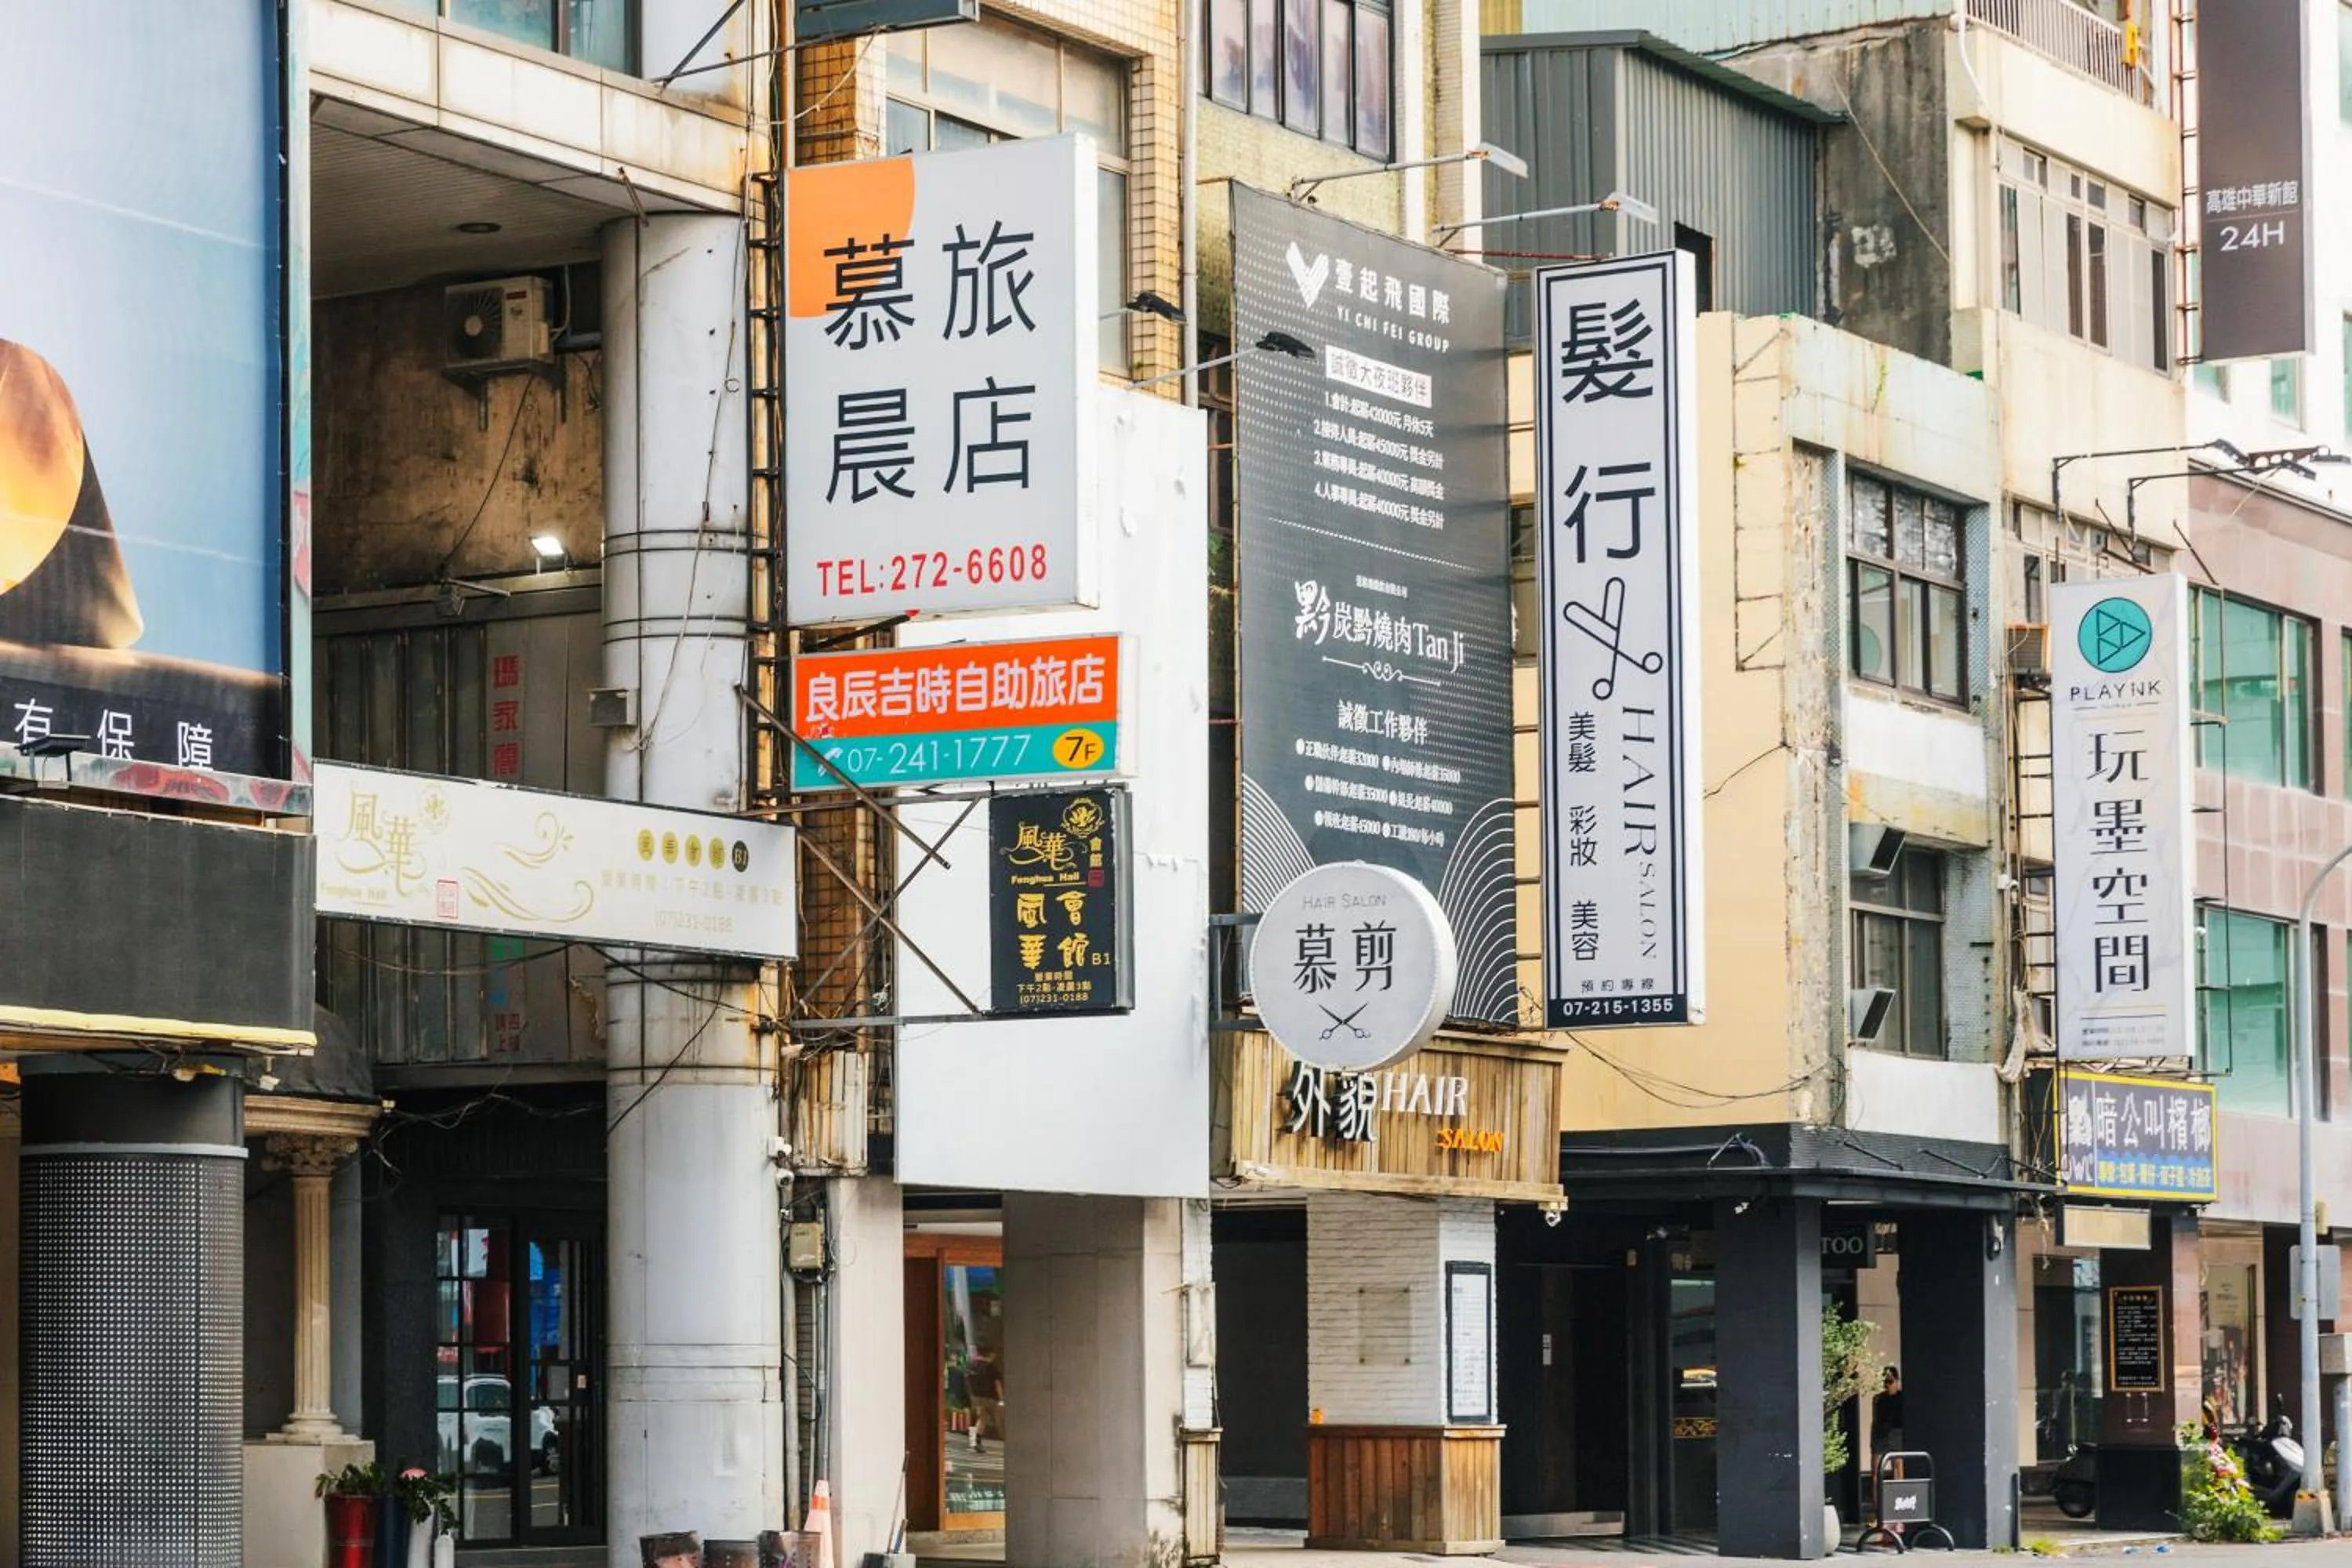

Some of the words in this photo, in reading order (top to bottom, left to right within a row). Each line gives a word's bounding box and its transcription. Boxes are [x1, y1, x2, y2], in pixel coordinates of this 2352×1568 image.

[2205, 180, 2299, 213] 高雄中華新館
[2220, 220, 2285, 252] 24H
[1335, 257, 1450, 325] 壹起飛國際
[1338, 305, 1349, 322] YI
[1355, 313, 1377, 332] CHI
[1383, 321, 1403, 339] FEI
[1408, 329, 1450, 353] GROUP
[1561, 297, 1657, 564] 髮行
[804, 652, 1106, 723] 良辰吉時自助旅店
[847, 734, 1032, 775] 07-241-1777
[1569, 711, 1596, 773] 美髮
[1622, 706, 1657, 855] HAIR
[1569, 805, 1598, 866] 彩妝
[2086, 729, 2150, 993] 玩墨空間
[1571, 900, 1599, 960] 美容
[1639, 862, 1657, 959] SALON
[1091, 953, 1111, 966] B1
[1563, 997, 1673, 1016] 07-215-1355
[1381, 1072, 1468, 1116] HAIR
[1439, 1129, 1504, 1152] SALON
